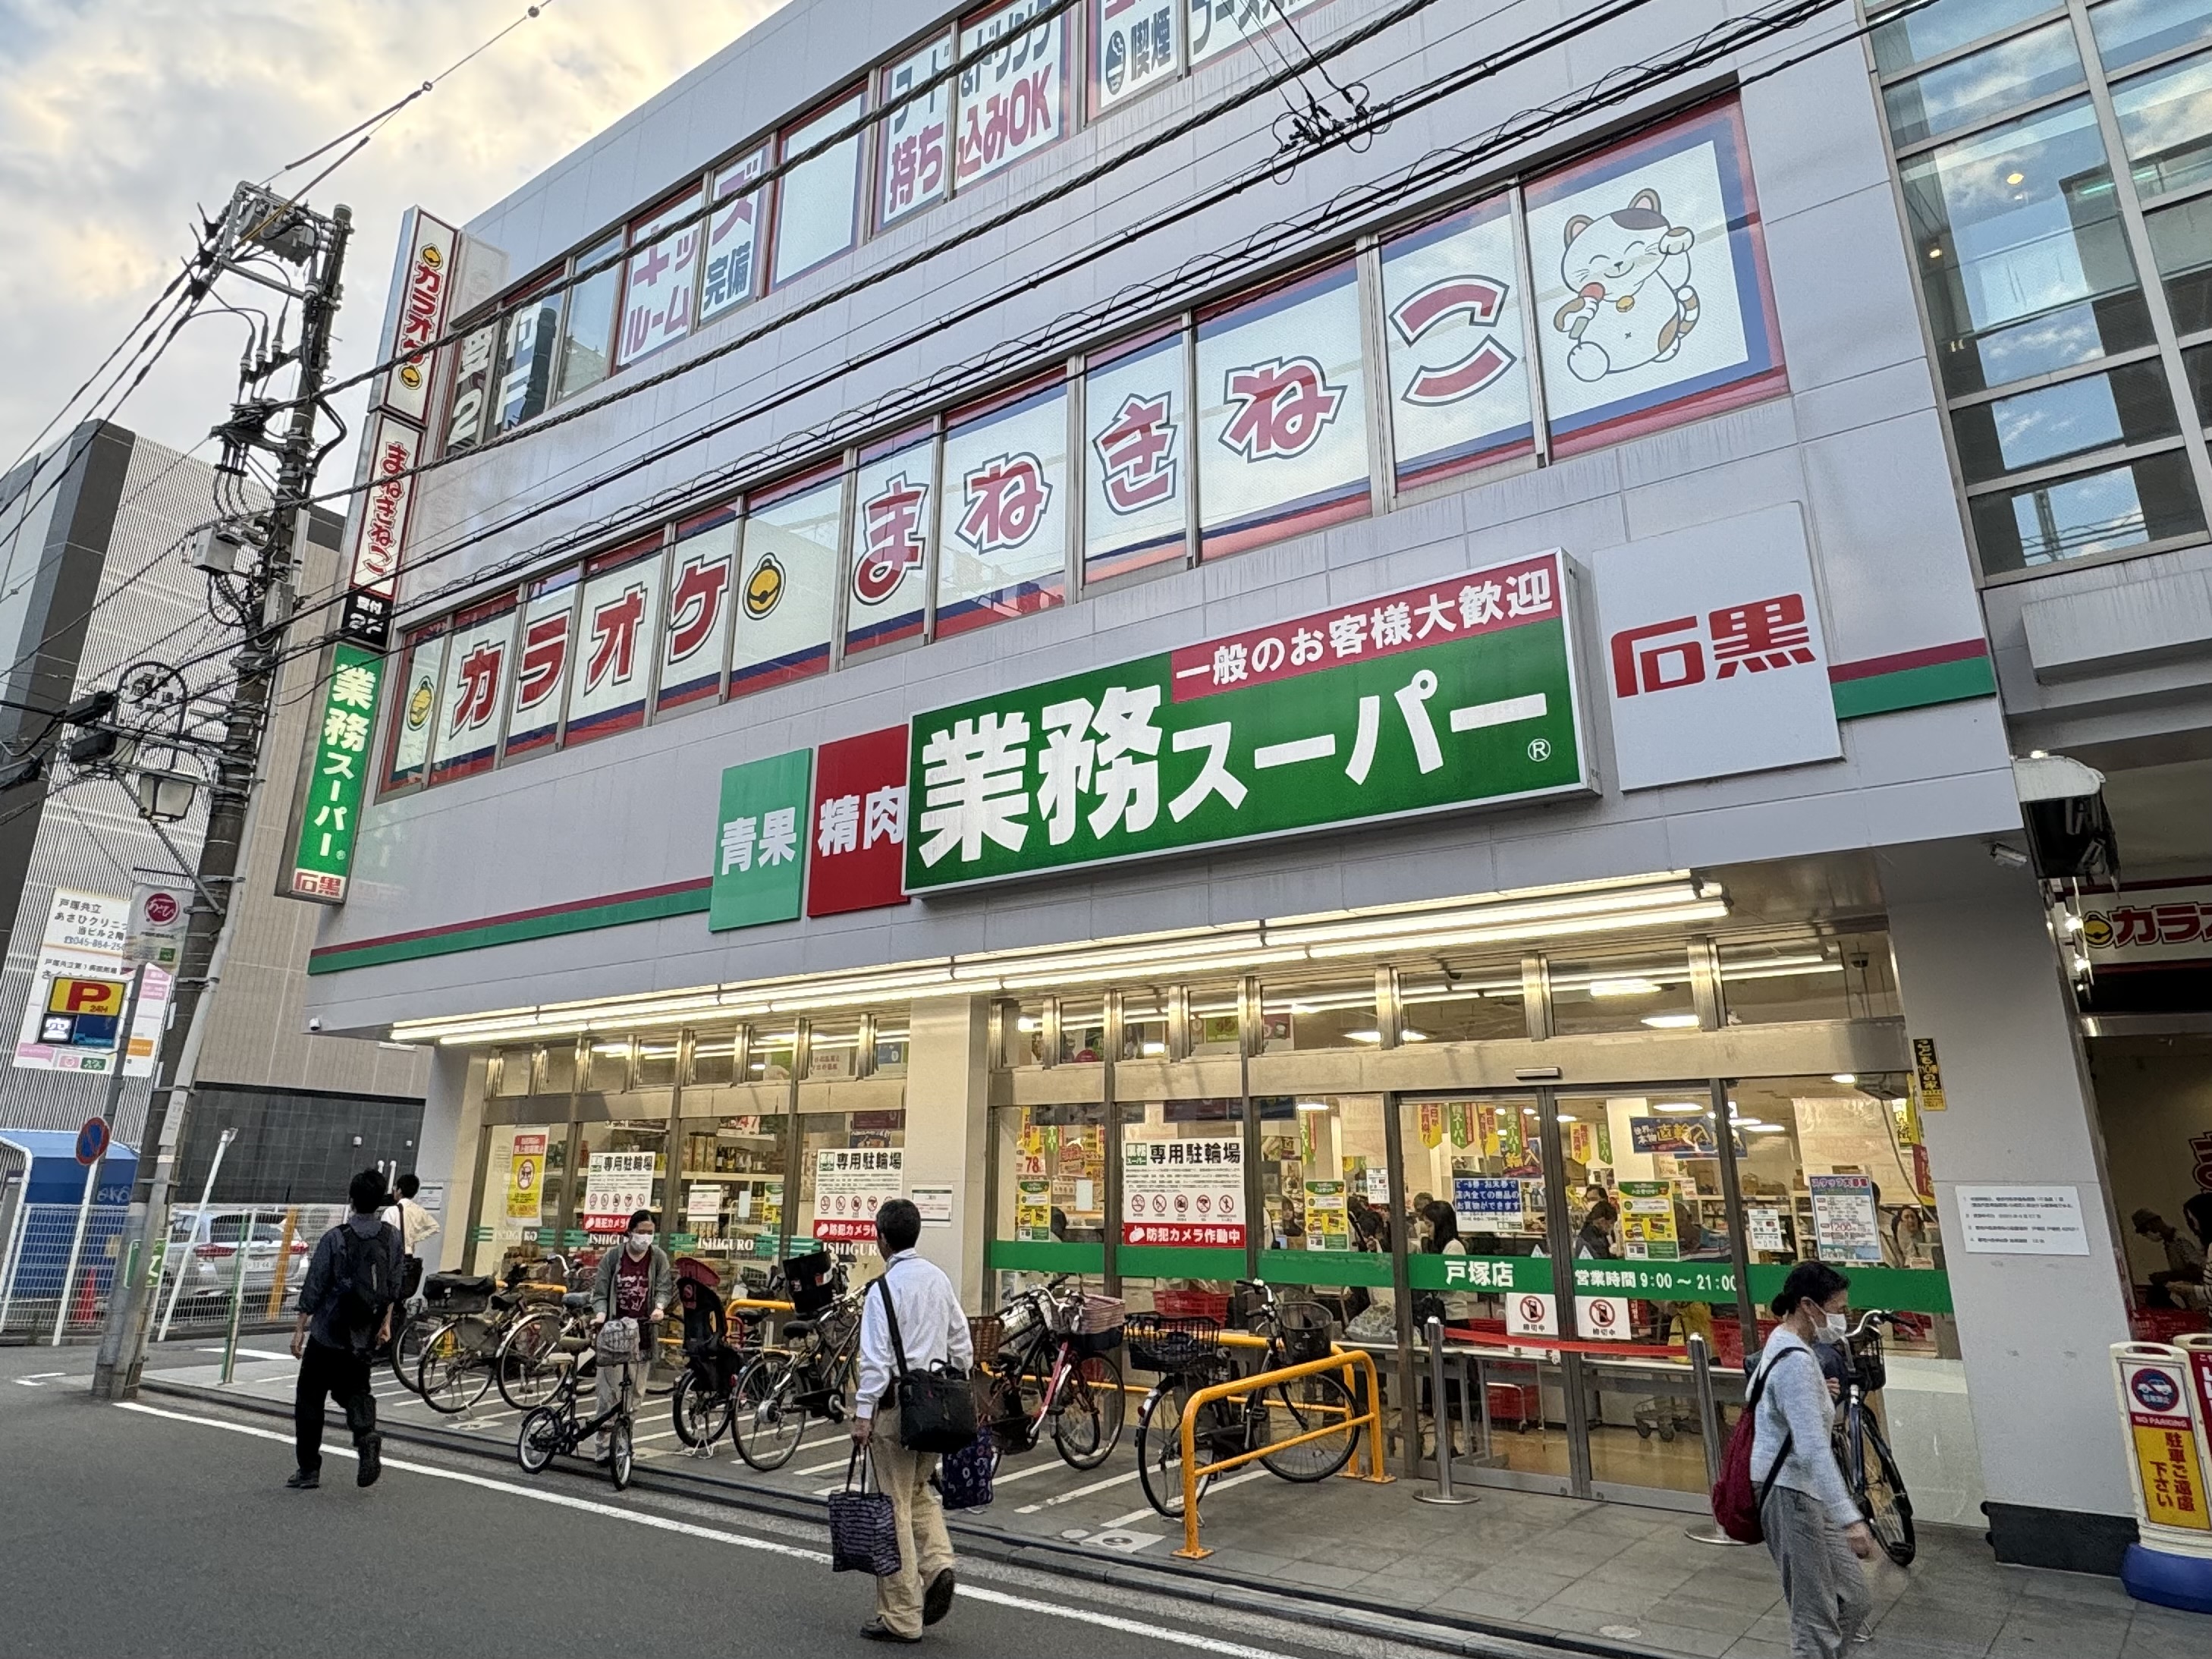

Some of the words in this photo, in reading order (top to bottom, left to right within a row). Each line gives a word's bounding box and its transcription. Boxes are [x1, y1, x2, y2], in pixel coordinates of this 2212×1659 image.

[1131, 5, 1171, 82] 喫煙
[889, 61, 1053, 215] 持ち込みOK
[703, 240, 751, 312] 完備
[851, 273, 1517, 605] まねきねこ
[450, 553, 733, 740] カラオケ
[1175, 567, 1554, 687] 一般のお客様大歓迎
[1610, 593, 1817, 699] 石黒
[314, 662, 375, 857] 業務スーパー
[918, 668, 1547, 869] 業務スーパー
[720, 806, 798, 877] 青果
[817, 785, 906, 858] 精肉
[294, 872, 342, 897] 石黒
[2107, 901, 2212, 949] カラ
[66, 981, 112, 1012] P
[1149, 1142, 1241, 1164] 専用駐輪場
[697, 1237, 754, 1251] ISHIGURO
[1146, 1227, 1241, 1244] 防犯カメラ作動中
[1444, 1260, 1515, 1287] 戸塚店
[1574, 1269, 1637, 1289] 営業時間
[1640, 1272, 1673, 1289] 9:00
[2135, 1415, 2148, 1426] NO
[2149, 1417, 2188, 1429] PARKING
[2150, 1460, 2174, 1508] 下さい
[2165, 1431, 2197, 1512] 駐車ご遠慮
